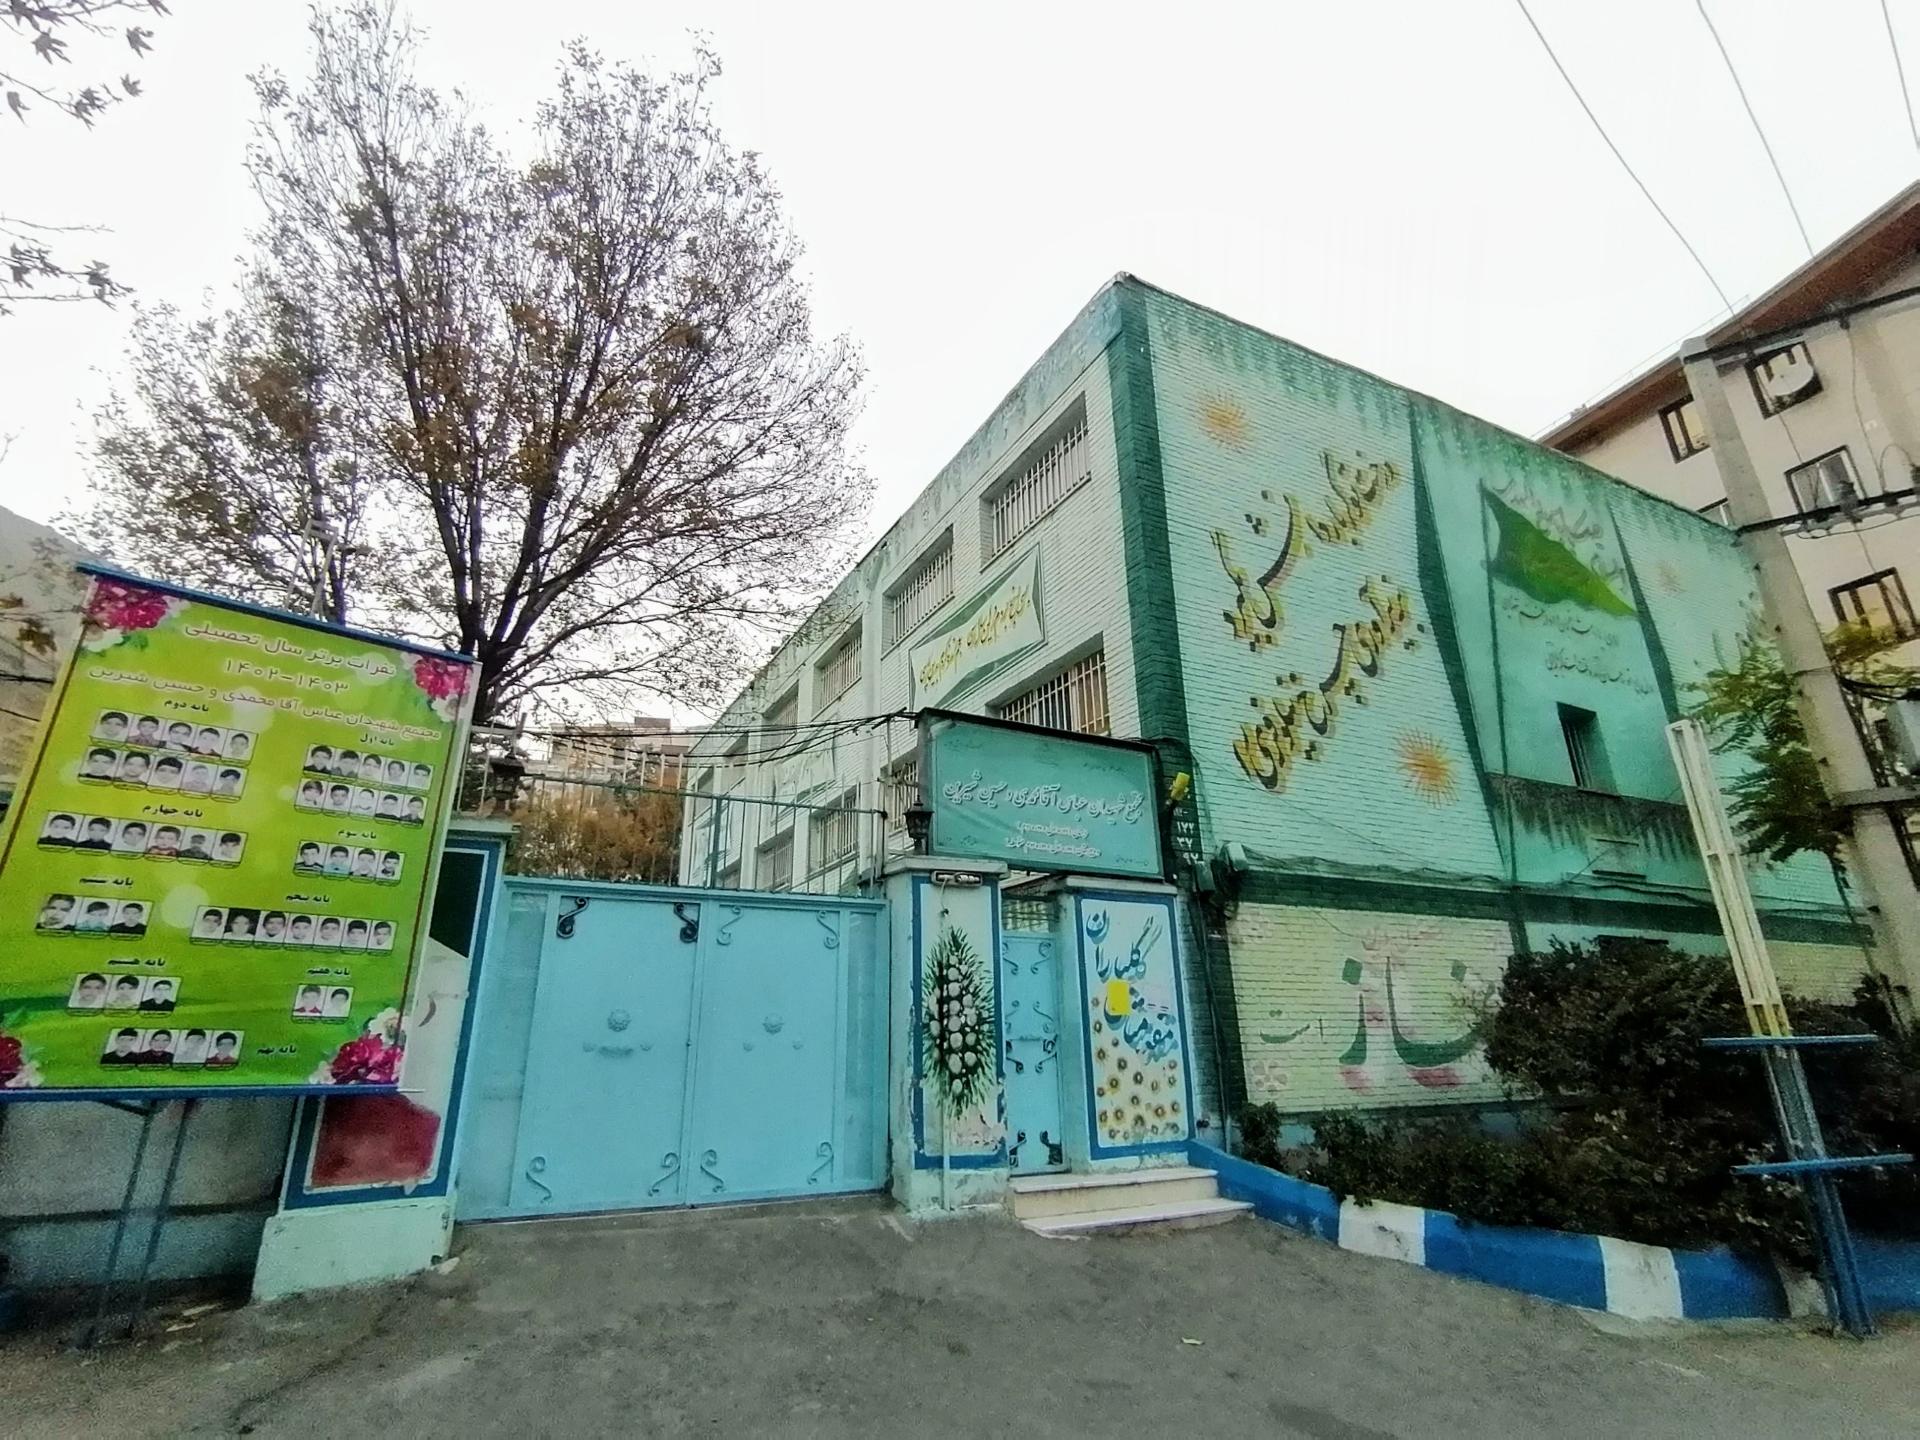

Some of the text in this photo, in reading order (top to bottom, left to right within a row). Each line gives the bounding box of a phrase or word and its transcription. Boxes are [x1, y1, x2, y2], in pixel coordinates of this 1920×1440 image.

[184, 623, 395, 677] نفرات برتر سال تحصیلی
[88, 667, 149, 684] شیرین
[153, 677, 205, 692] حسین
[209, 688, 218, 699] و
[163, 699, 187, 710] دوم
[302, 706, 343, 722] عباس
[345, 714, 399, 733] شهیدان
[359, 732, 378, 744] اول
[401, 724, 441, 741] مجتمع
[943, 769, 983, 805] شیرین
[978, 781, 1009, 809] حسین
[1056, 794, 1088, 822] عباس
[338, 829, 357, 839] سوم
